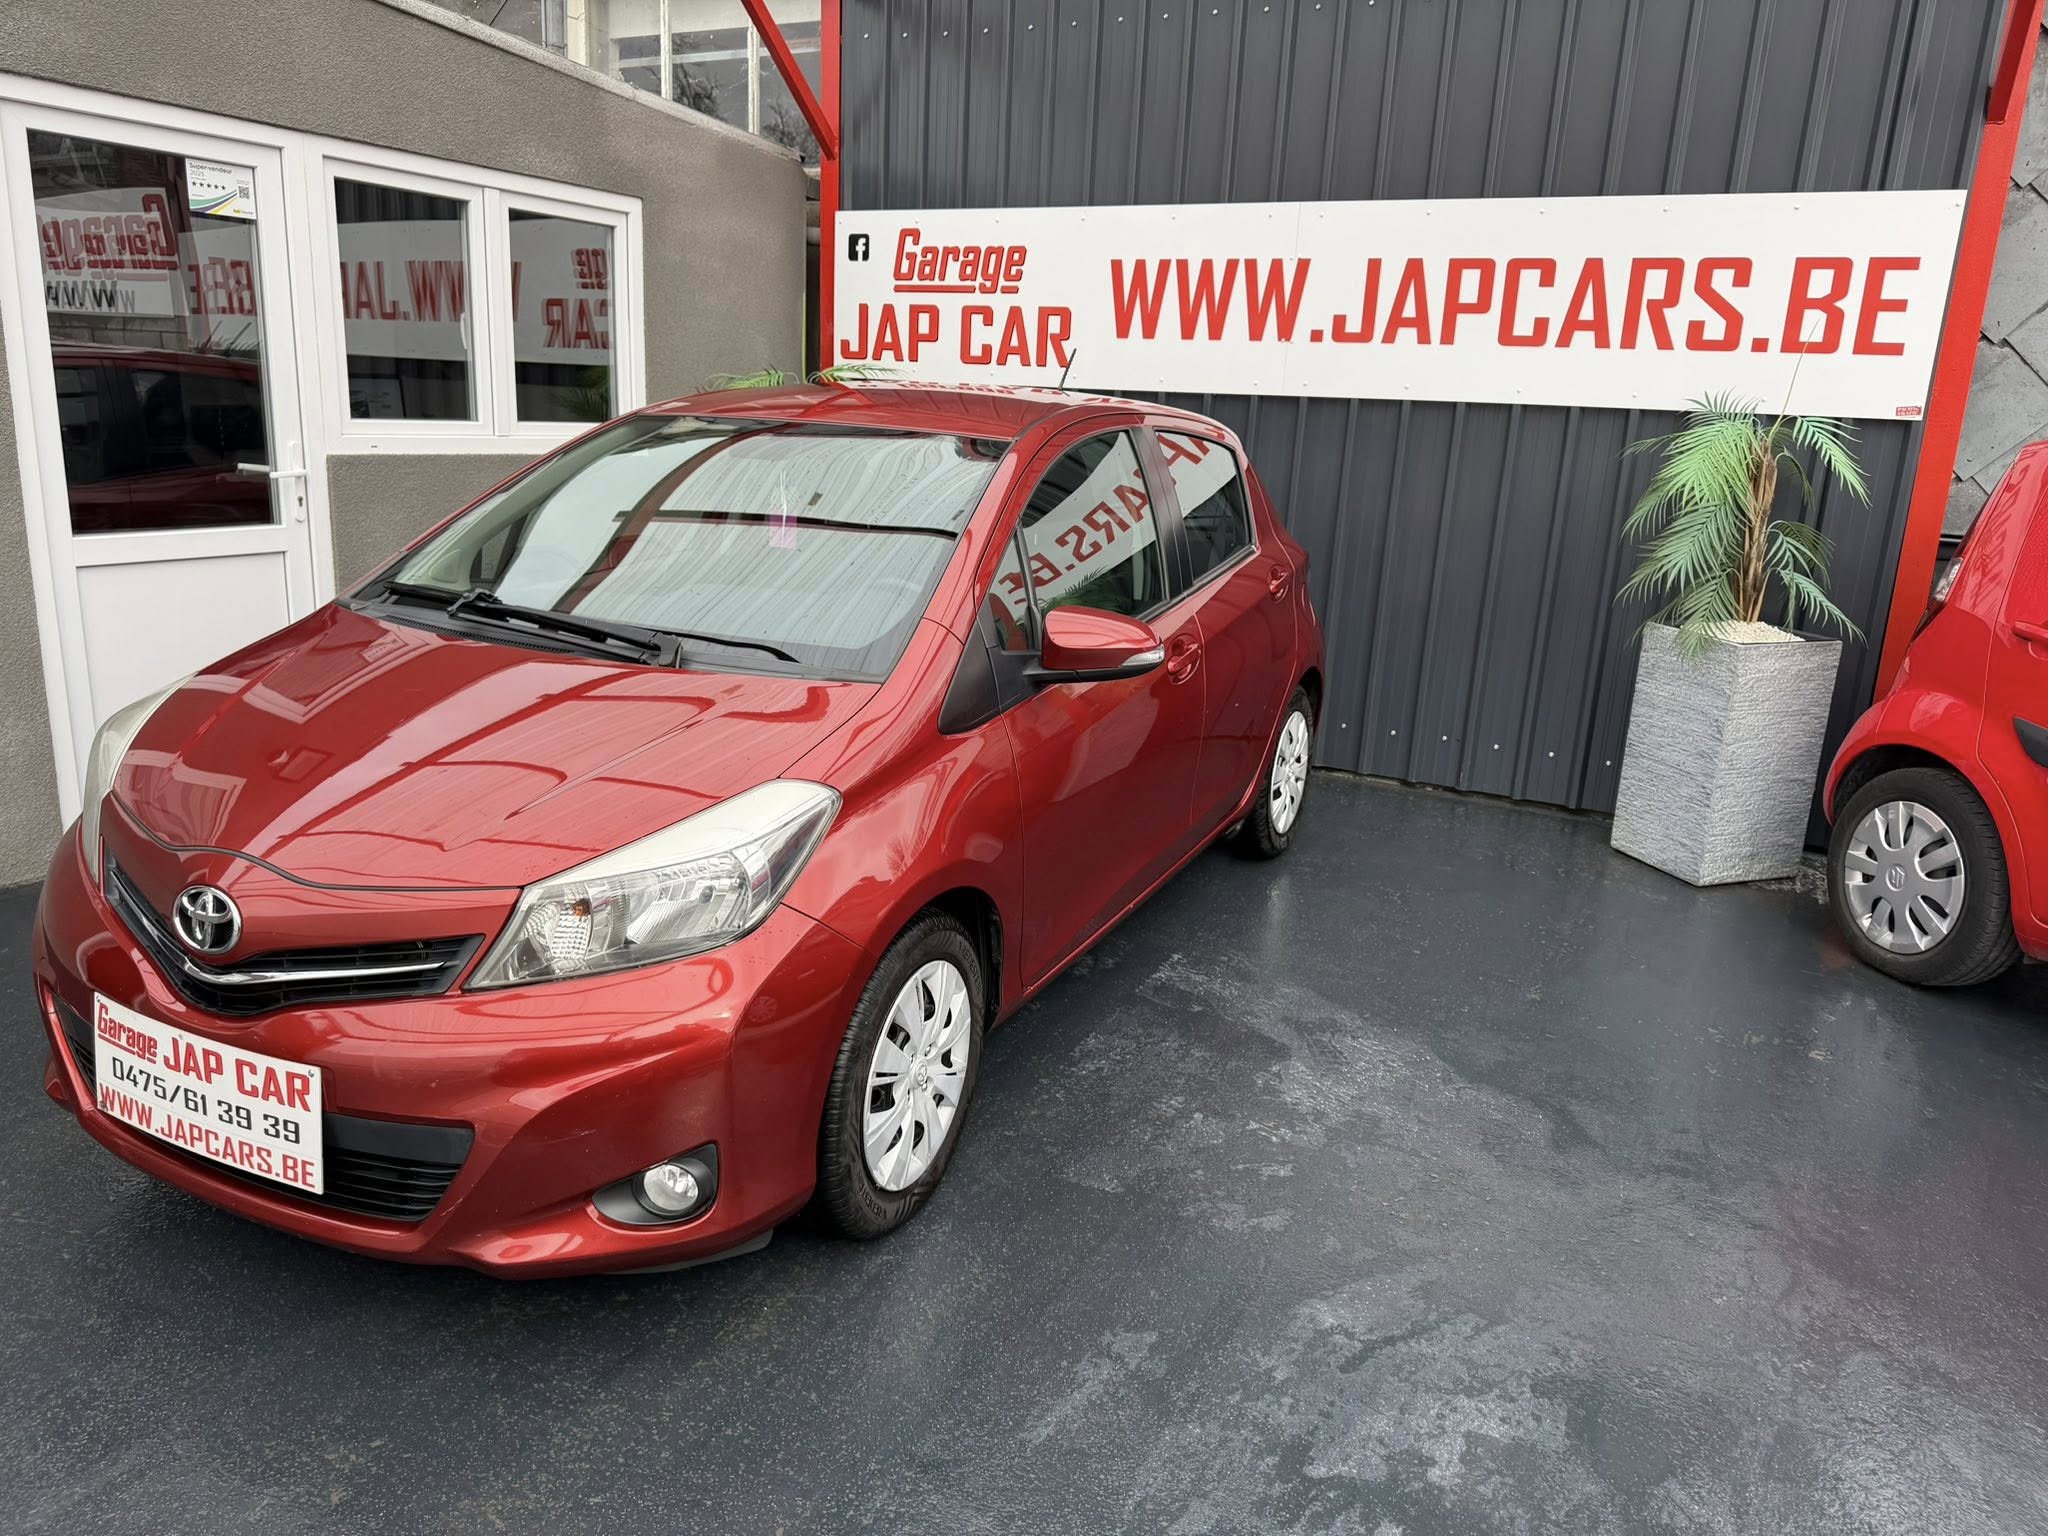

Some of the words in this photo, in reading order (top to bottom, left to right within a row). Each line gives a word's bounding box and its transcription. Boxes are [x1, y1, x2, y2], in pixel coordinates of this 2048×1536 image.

[893, 227, 1027, 294] Garage
[1111, 257, 1921, 356] WWW.JAPCARS.BE
[840, 303, 940, 362] JAP
[960, 305, 1072, 368] CAR
[97, 1002, 158, 1065] Garage
[163, 1036, 224, 1085] JAP
[235, 1058, 311, 1113] CAR
[111, 1056, 208, 1117] 0475/61
[217, 1099, 252, 1131] 39
[263, 1113, 301, 1145] 39
[99, 1082, 316, 1189] WWW.JAPCARS.BE
